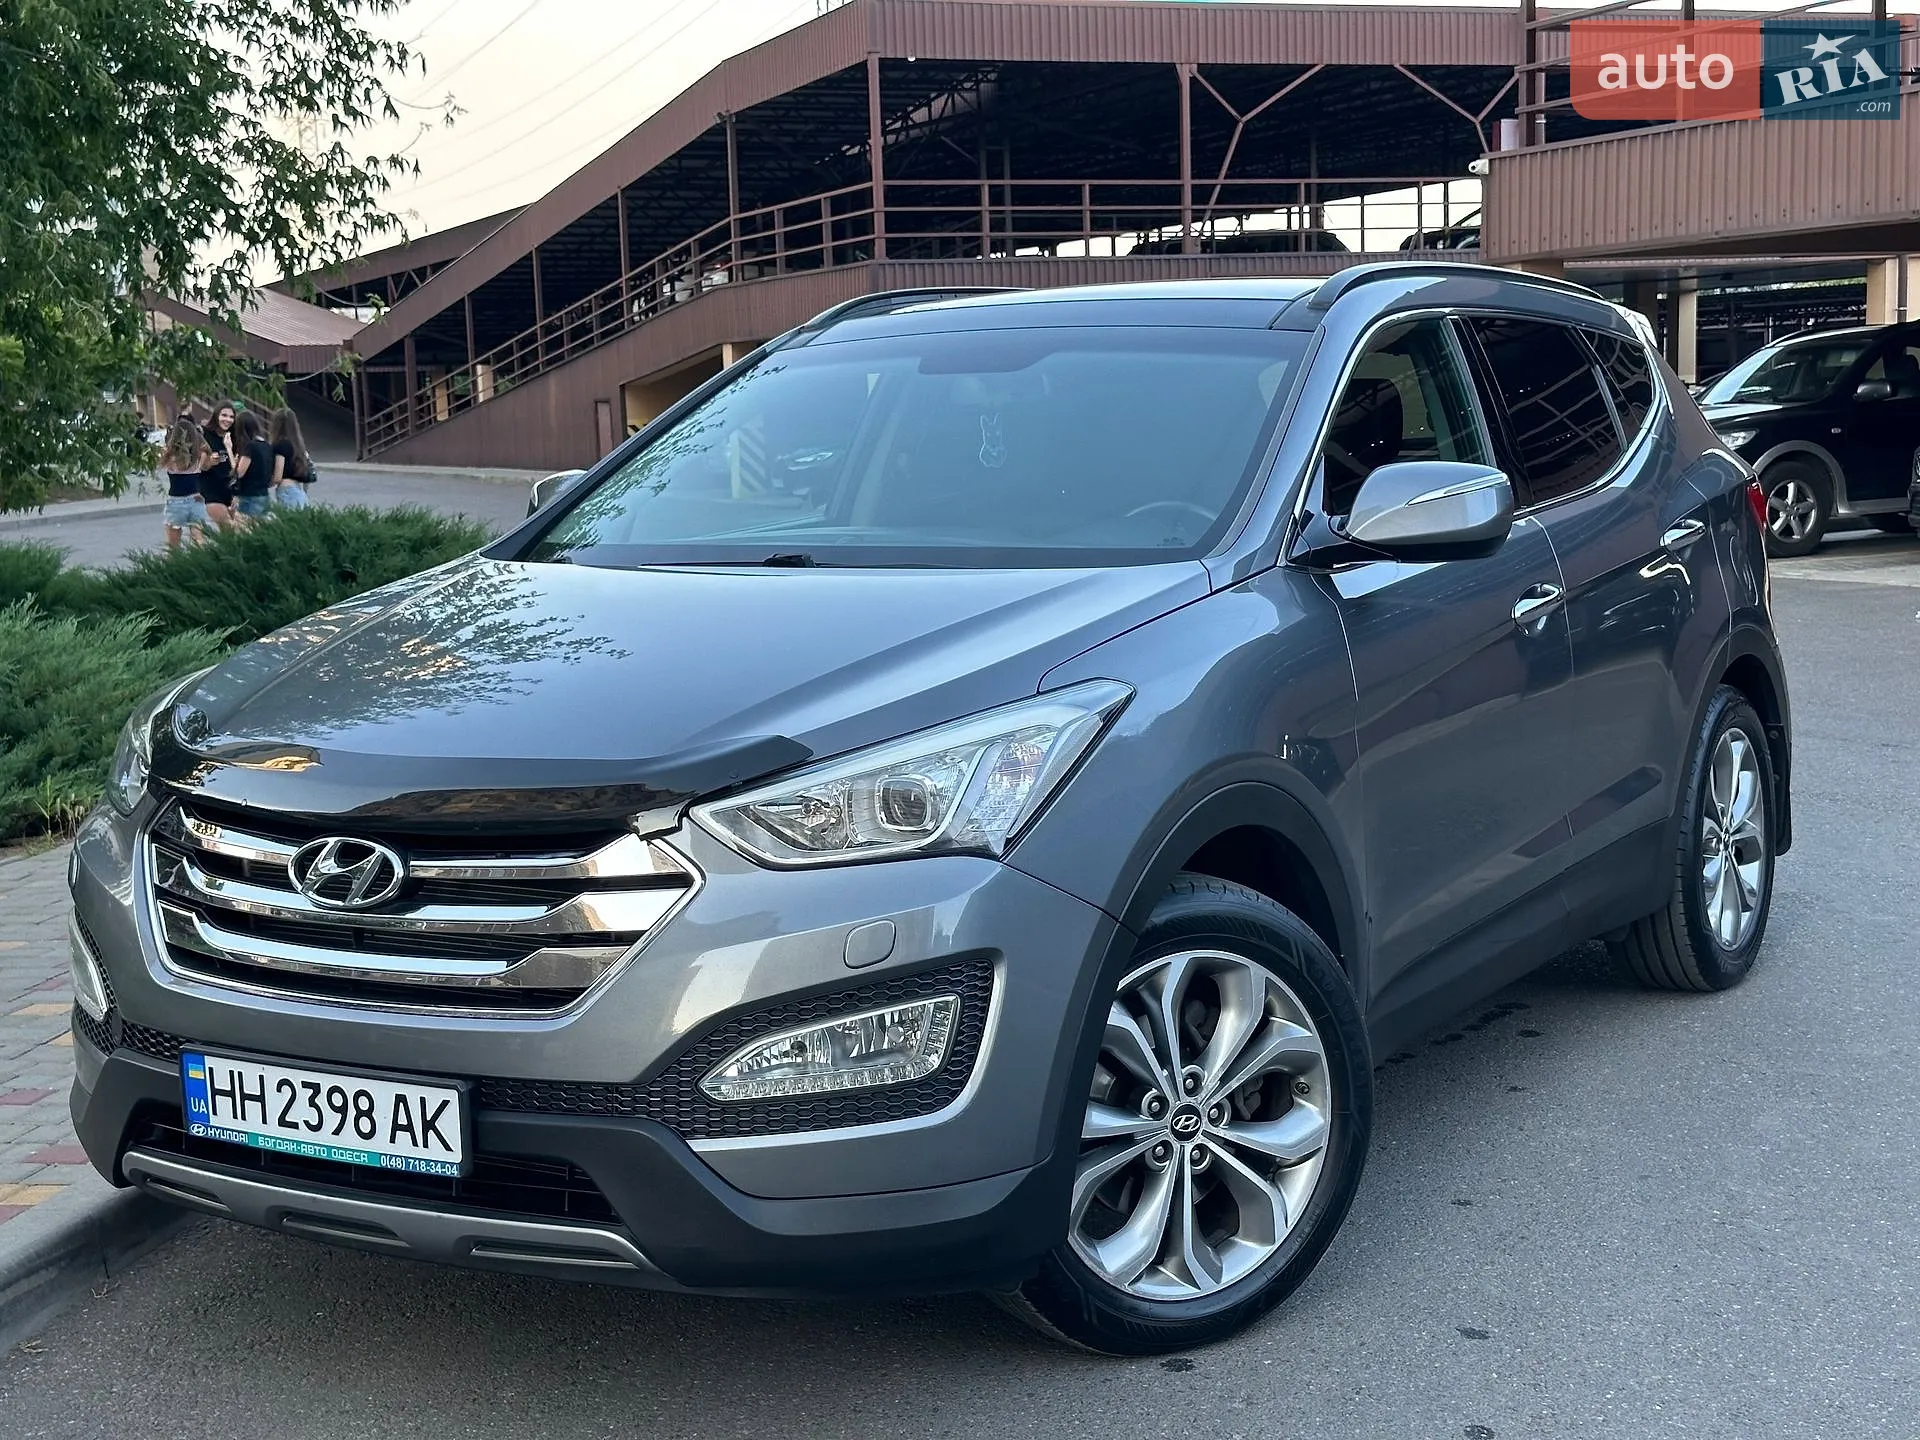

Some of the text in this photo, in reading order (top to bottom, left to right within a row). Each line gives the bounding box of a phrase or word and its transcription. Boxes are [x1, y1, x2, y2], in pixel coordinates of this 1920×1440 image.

[191, 1097, 207, 1115] UA
[208, 1066, 454, 1153] HH 2398 AK
[207, 1125, 249, 1144] HYUNDAI
[331, 1149, 369, 1163] ОДЕСА
[381, 1155, 458, 1176] 0(48) 718-34-04
